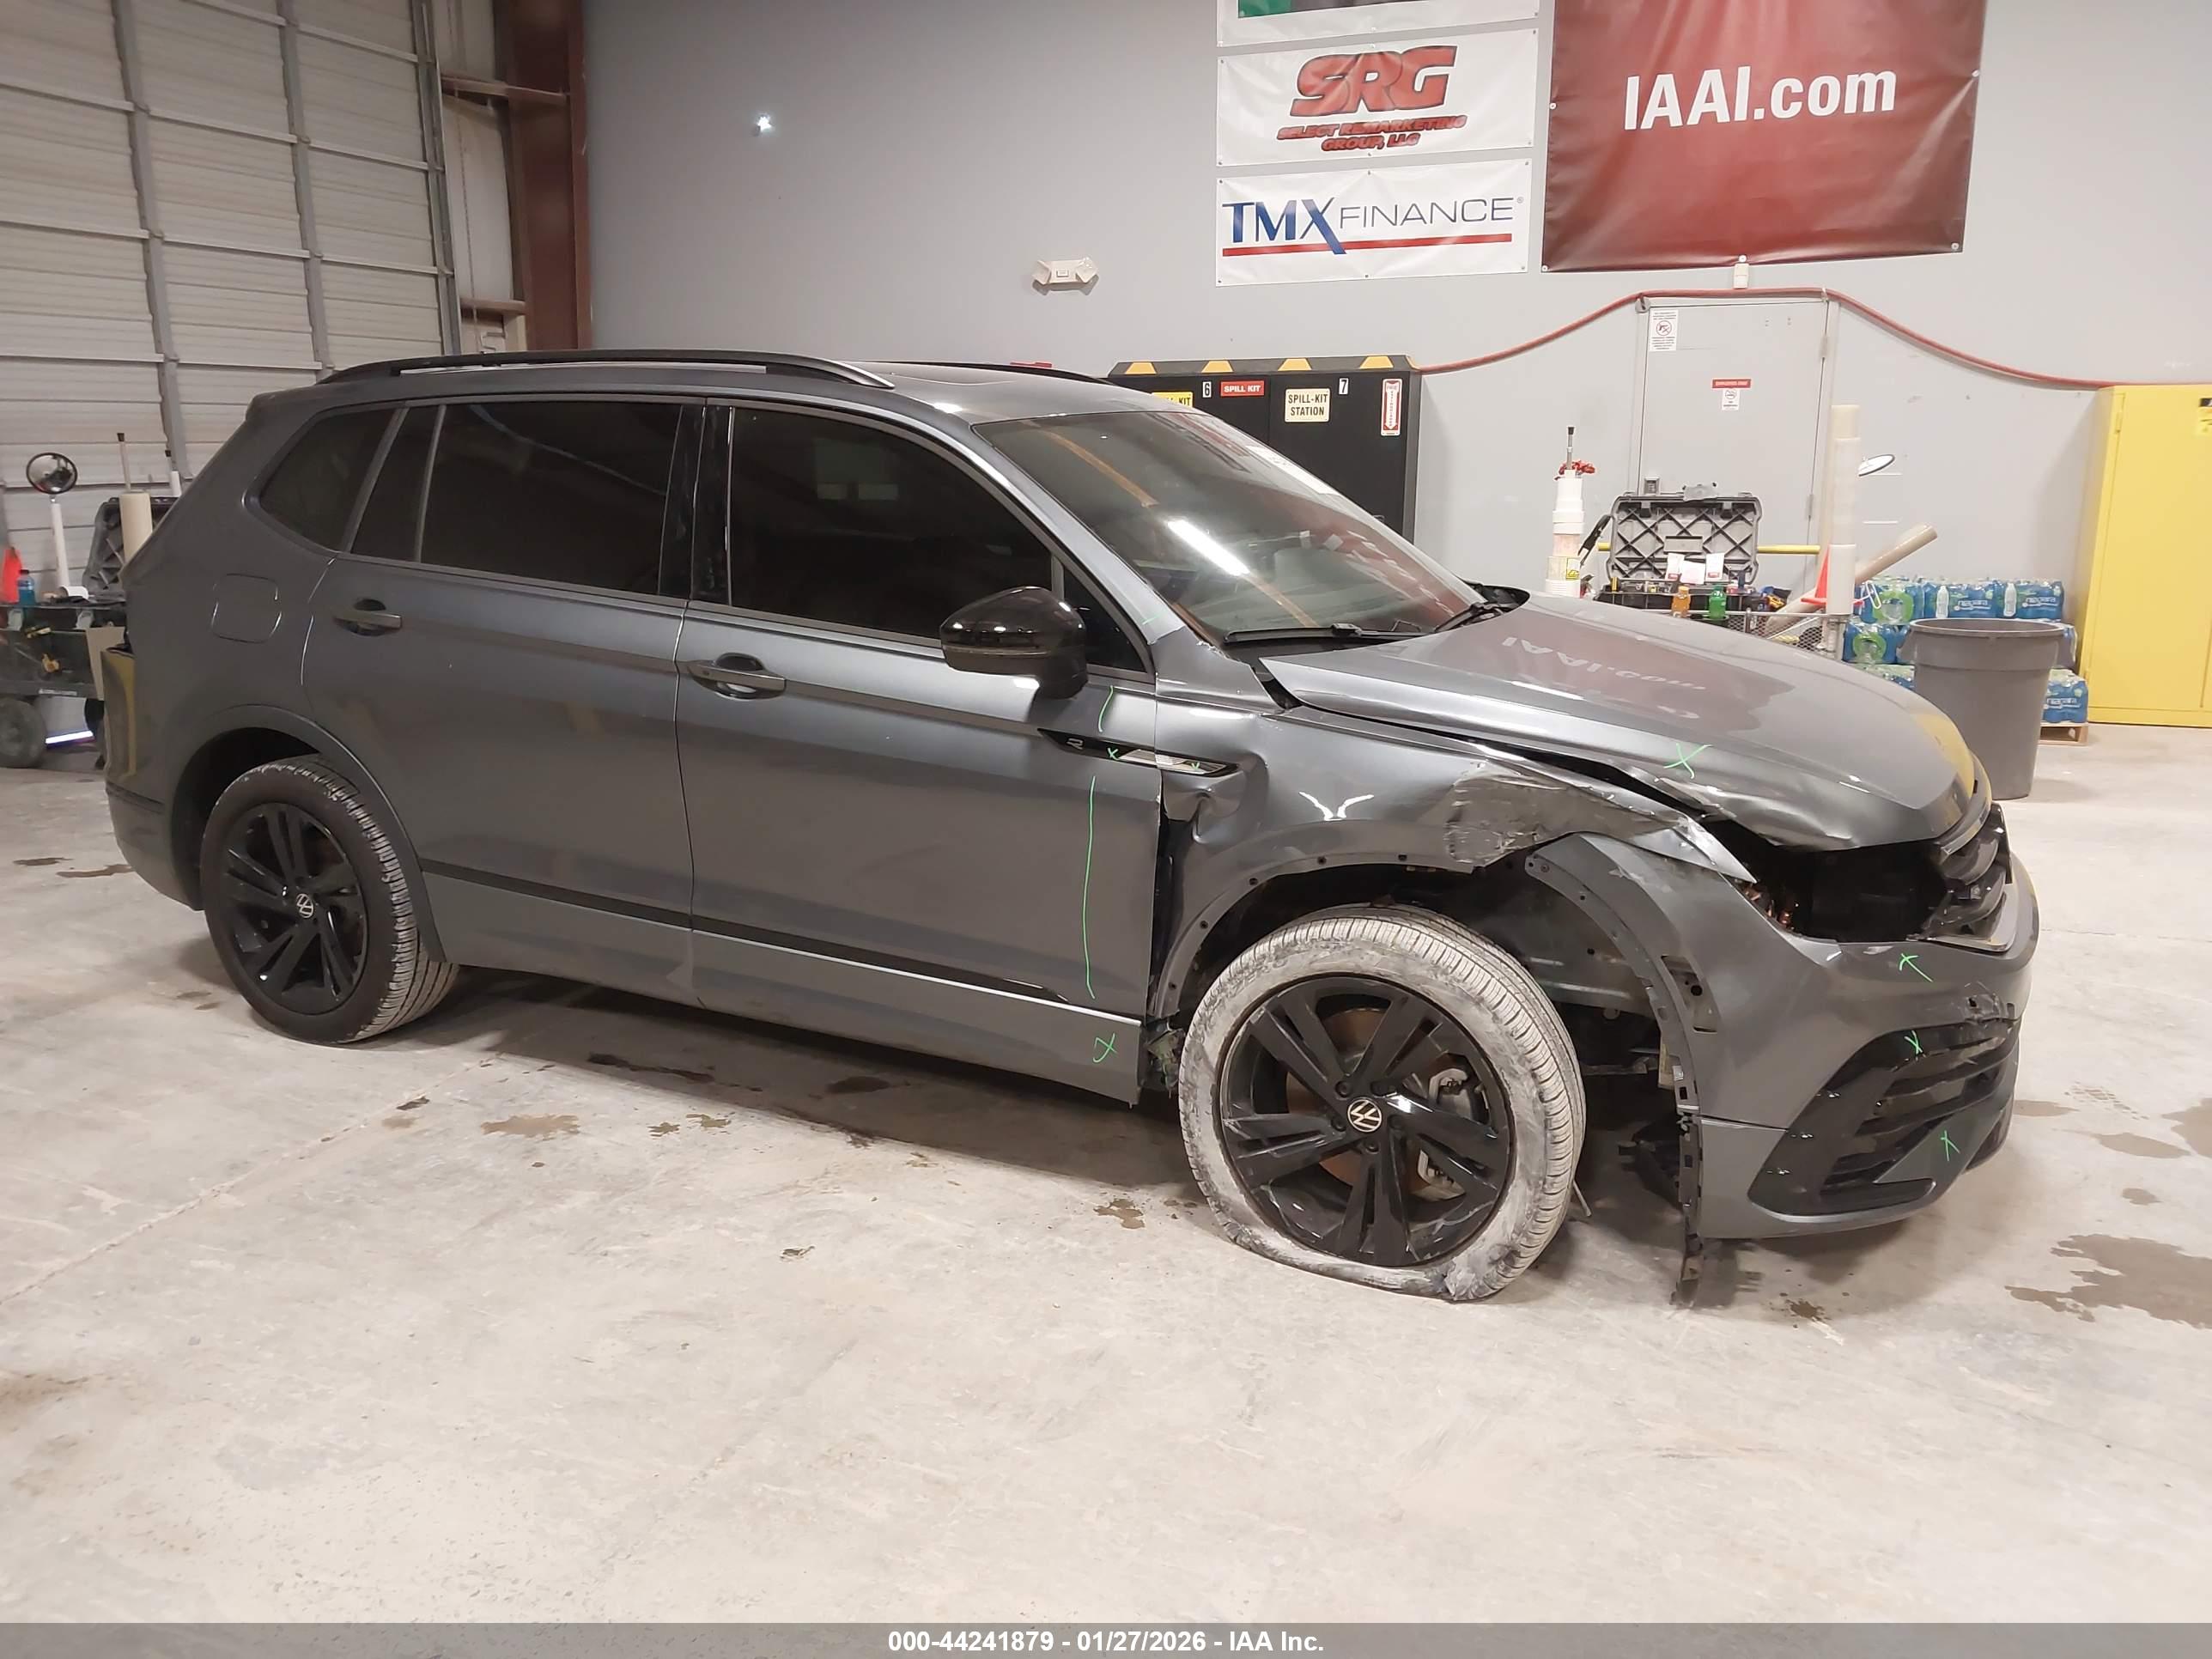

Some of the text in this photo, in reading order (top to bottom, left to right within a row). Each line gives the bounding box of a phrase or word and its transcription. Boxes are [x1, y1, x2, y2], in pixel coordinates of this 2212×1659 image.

[1290, 46, 1457, 117] SRG
[1624, 66, 1897, 131] IAAI.com
[1277, 115, 1468, 140] SELECT REMARKETING
[1321, 133, 1420, 151] GROUP, LLC
[1204, 382, 1211, 397] 6
[1224, 385, 1246, 393] SPILL
[1340, 379, 1347, 394] 7
[1288, 393, 1328, 404] SPILL-KIT
[1291, 406, 1325, 416] STATION
